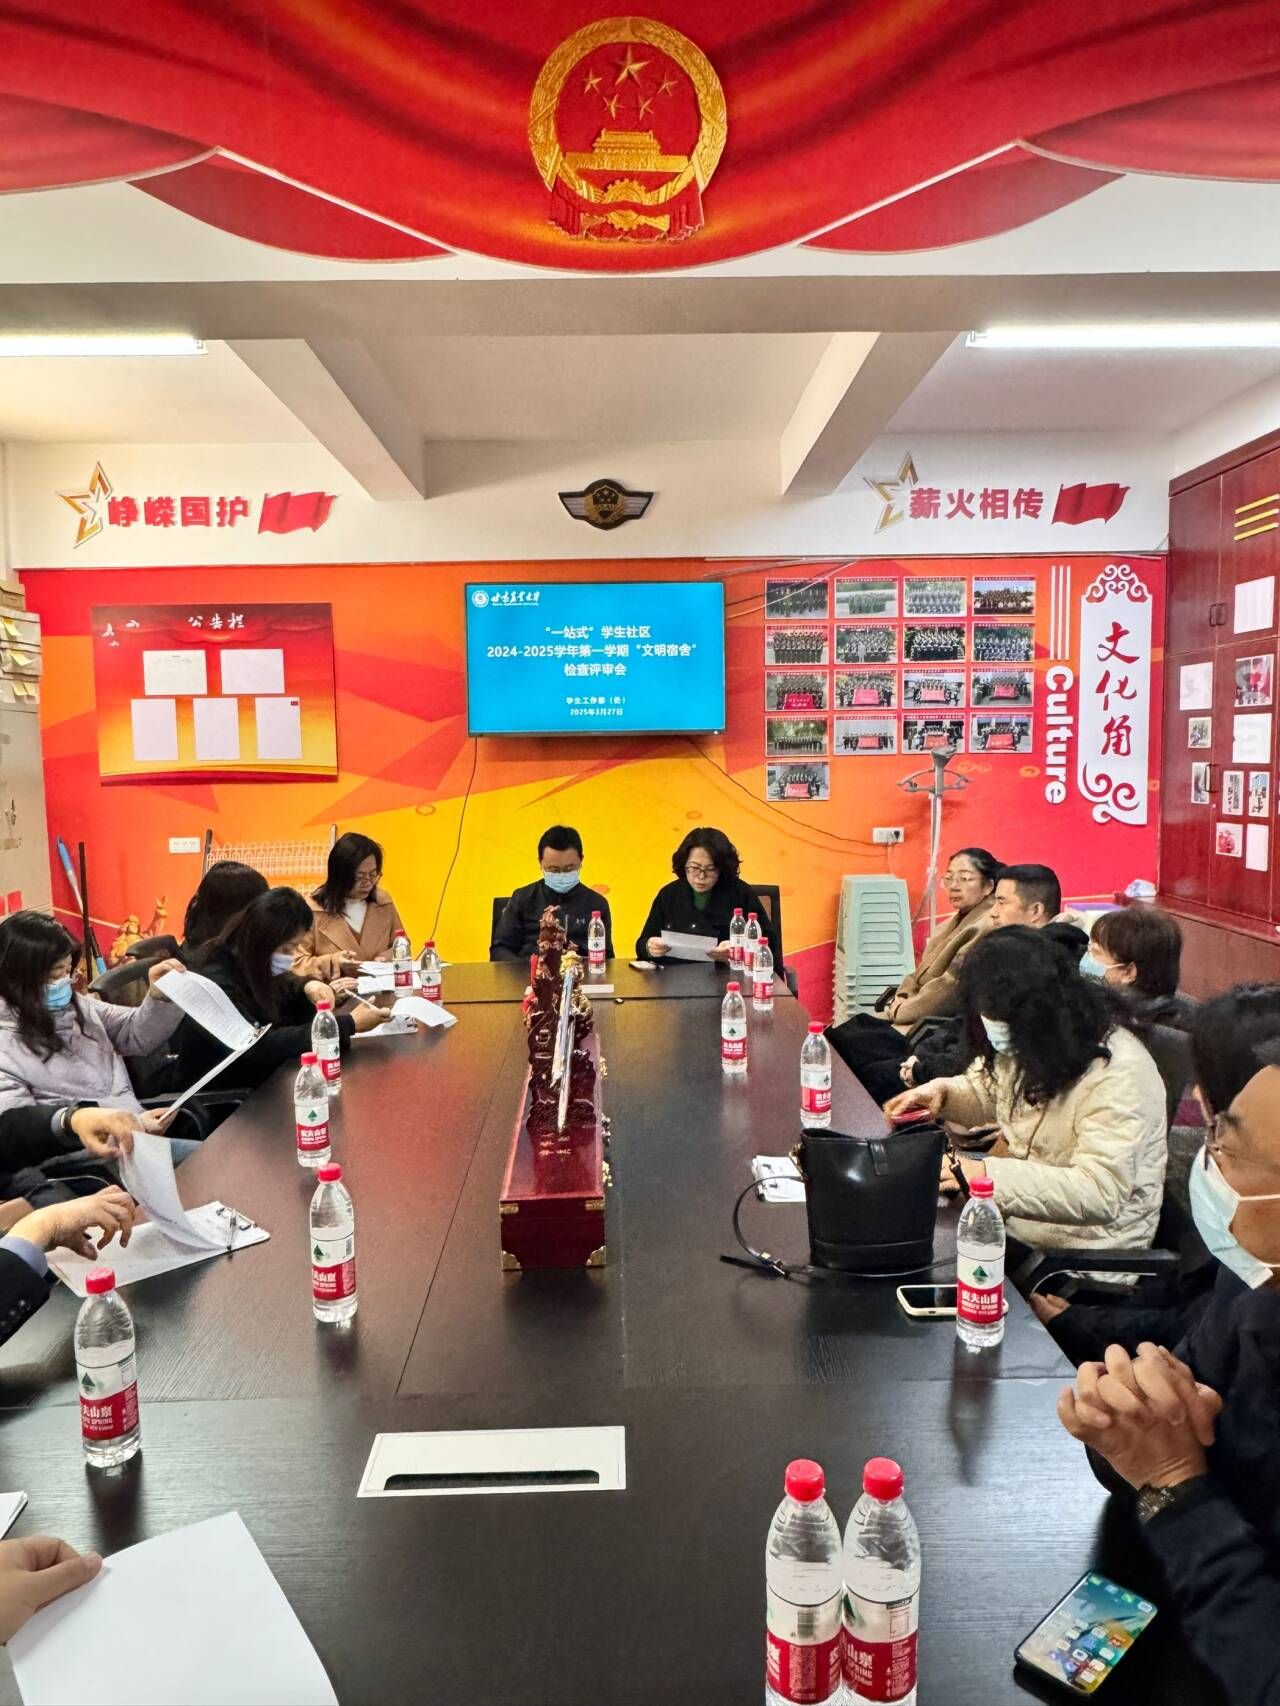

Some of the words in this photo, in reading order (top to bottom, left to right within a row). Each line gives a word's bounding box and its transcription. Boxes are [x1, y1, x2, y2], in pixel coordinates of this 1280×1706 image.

[107, 496, 249, 528] 峥嵘国护
[908, 487, 1043, 520] 薪火相传
[187, 613, 245, 630] 公告栏
[563, 663, 627, 677] 检查评审会
[1095, 621, 1141, 758] 文化角
[570, 708, 624, 716] 2025年3月27日
[1044, 665, 1074, 805] Culture
[82, 1404, 113, 1418] 夫山泉
